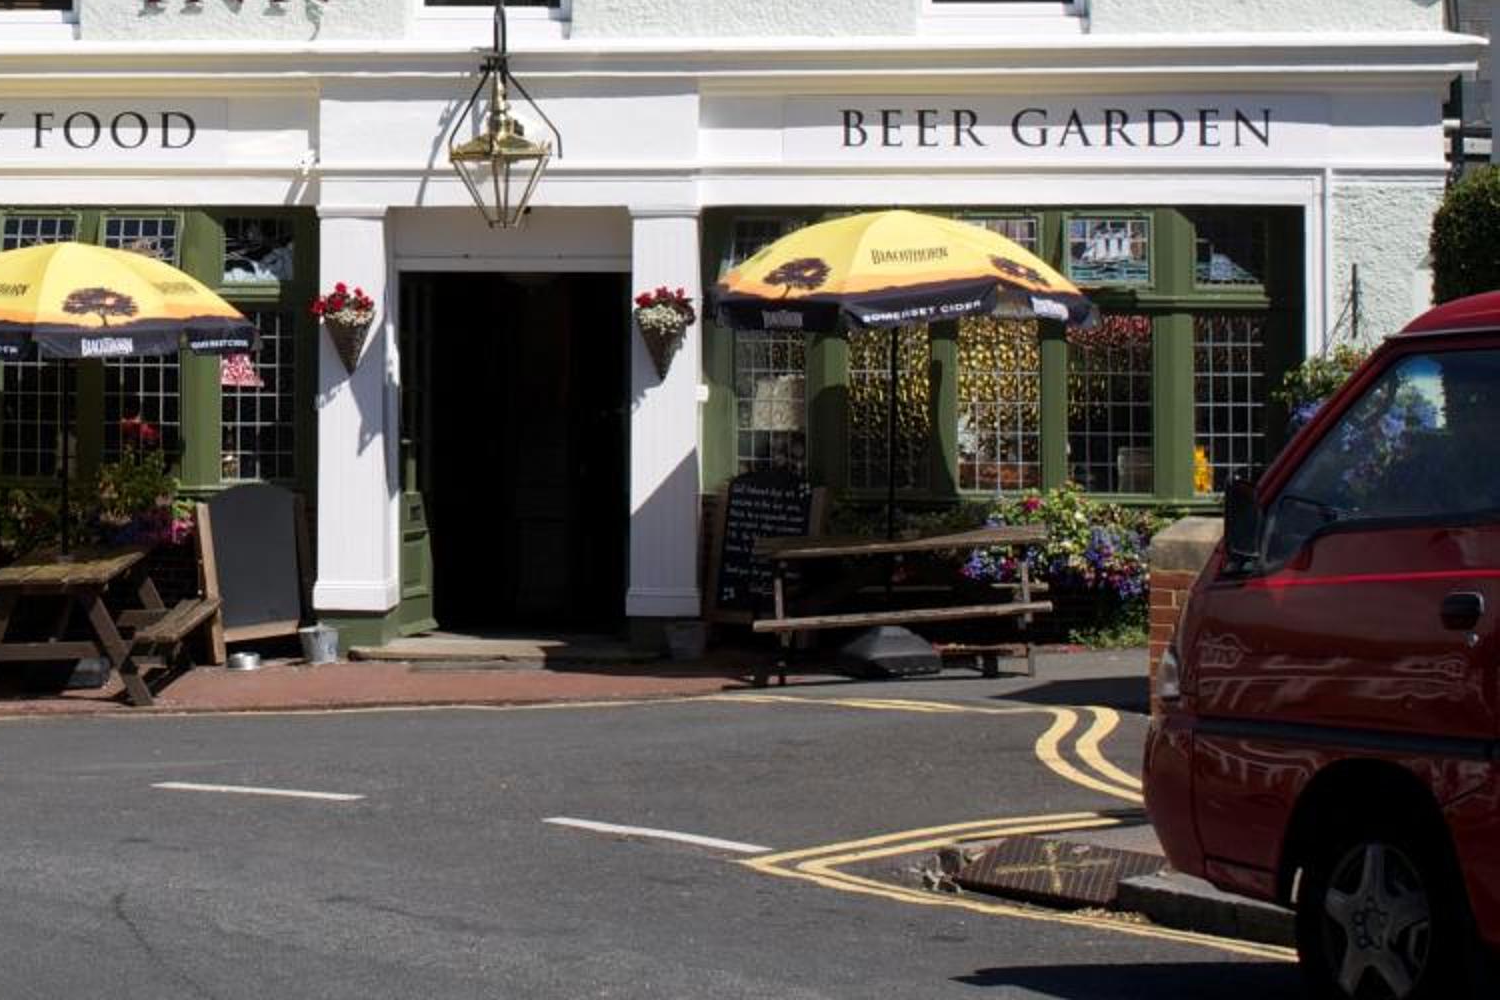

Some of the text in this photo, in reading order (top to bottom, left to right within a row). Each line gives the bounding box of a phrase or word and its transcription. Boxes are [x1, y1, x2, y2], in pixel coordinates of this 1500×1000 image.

[32, 111, 196, 149] FOOD
[839, 107, 1272, 148] BEER GARDEN
[862, 300, 982, 323] SOMERSET CIDER
